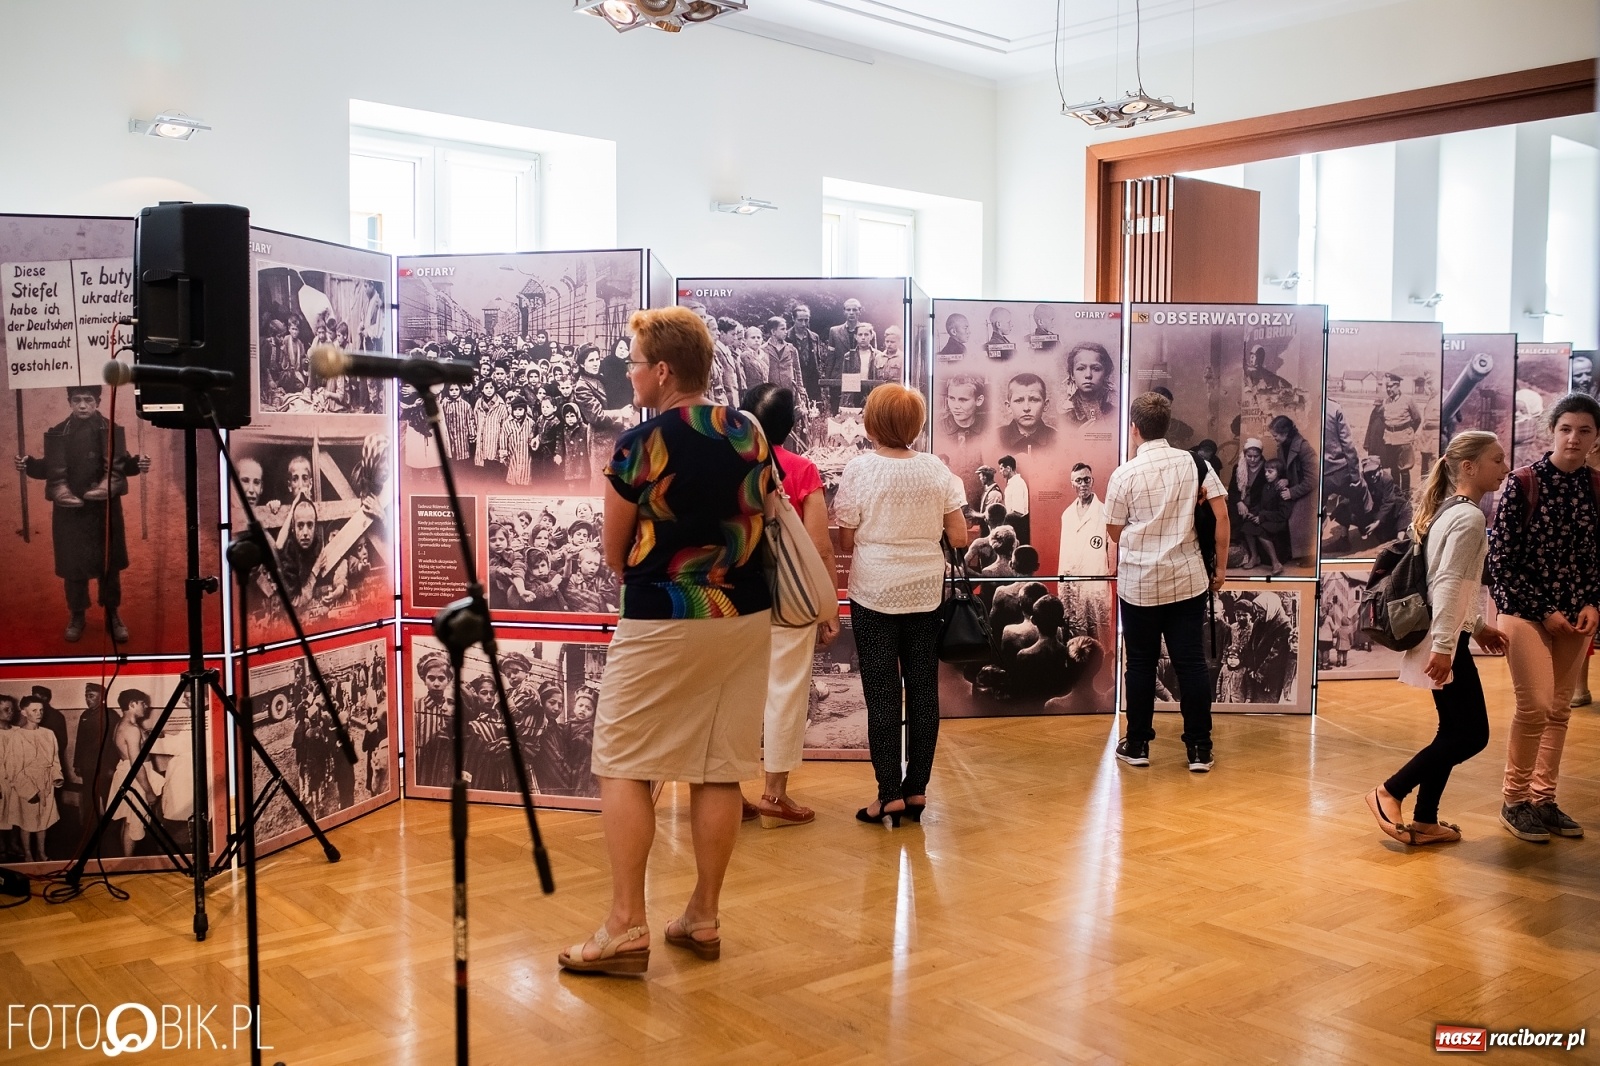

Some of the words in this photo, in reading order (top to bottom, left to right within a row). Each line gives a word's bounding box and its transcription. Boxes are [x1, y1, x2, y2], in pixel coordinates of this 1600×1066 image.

[14, 266, 46, 278] Diese
[80, 272, 93, 286] Te
[99, 266, 132, 288] buty
[416, 266, 455, 276] OFIARY
[12, 282, 58, 301] Stiefel
[10, 303, 38, 316] habe
[44, 303, 60, 315] ich
[8, 321, 24, 331] der
[26, 319, 73, 331] Deutschen
[1153, 312, 1294, 325] OBSERWATORZY
[16, 336, 70, 350] Wehrmacht
[88, 330, 134, 350] wojsku
[11, 358, 72, 375] gestohlen.
